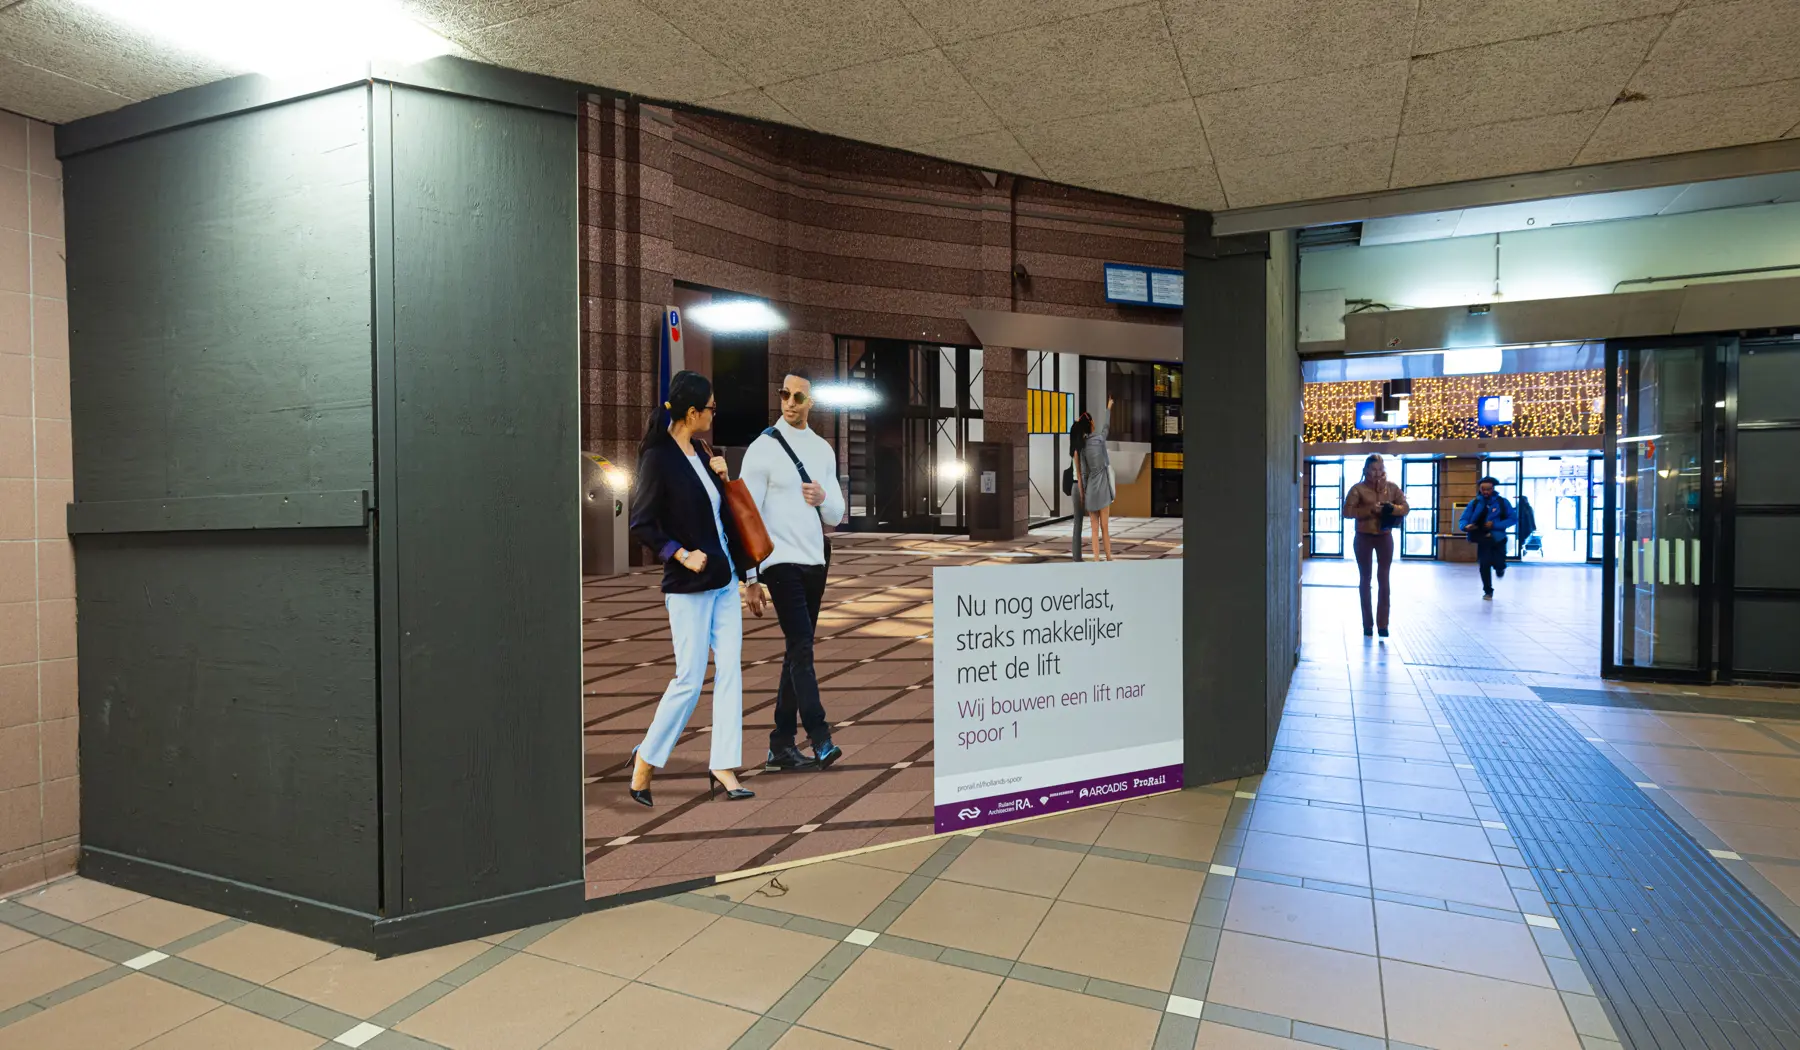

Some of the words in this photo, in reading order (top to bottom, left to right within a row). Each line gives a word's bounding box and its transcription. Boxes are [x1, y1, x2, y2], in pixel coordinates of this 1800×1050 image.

[957, 594, 986, 618] Nu
[995, 596, 1033, 619] nog
[1040, 587, 1114, 612] overlast,
[956, 625, 1015, 651] straks
[1023, 618, 1122, 646] makkelijker
[957, 660, 998, 684] met
[1005, 656, 1030, 678] de
[1037, 652, 1061, 677] lift
[957, 698, 985, 721] Wij
[991, 693, 1055, 715] bouwen
[1061, 690, 1088, 706] een
[1093, 684, 1111, 703] lift
[1116, 682, 1146, 700] naar
[958, 726, 1004, 750] spoor
[1011, 720, 1018, 739] 1
[1088, 781, 1128, 797] ARCADIS
[1133, 774, 1166, 788] ProRail
